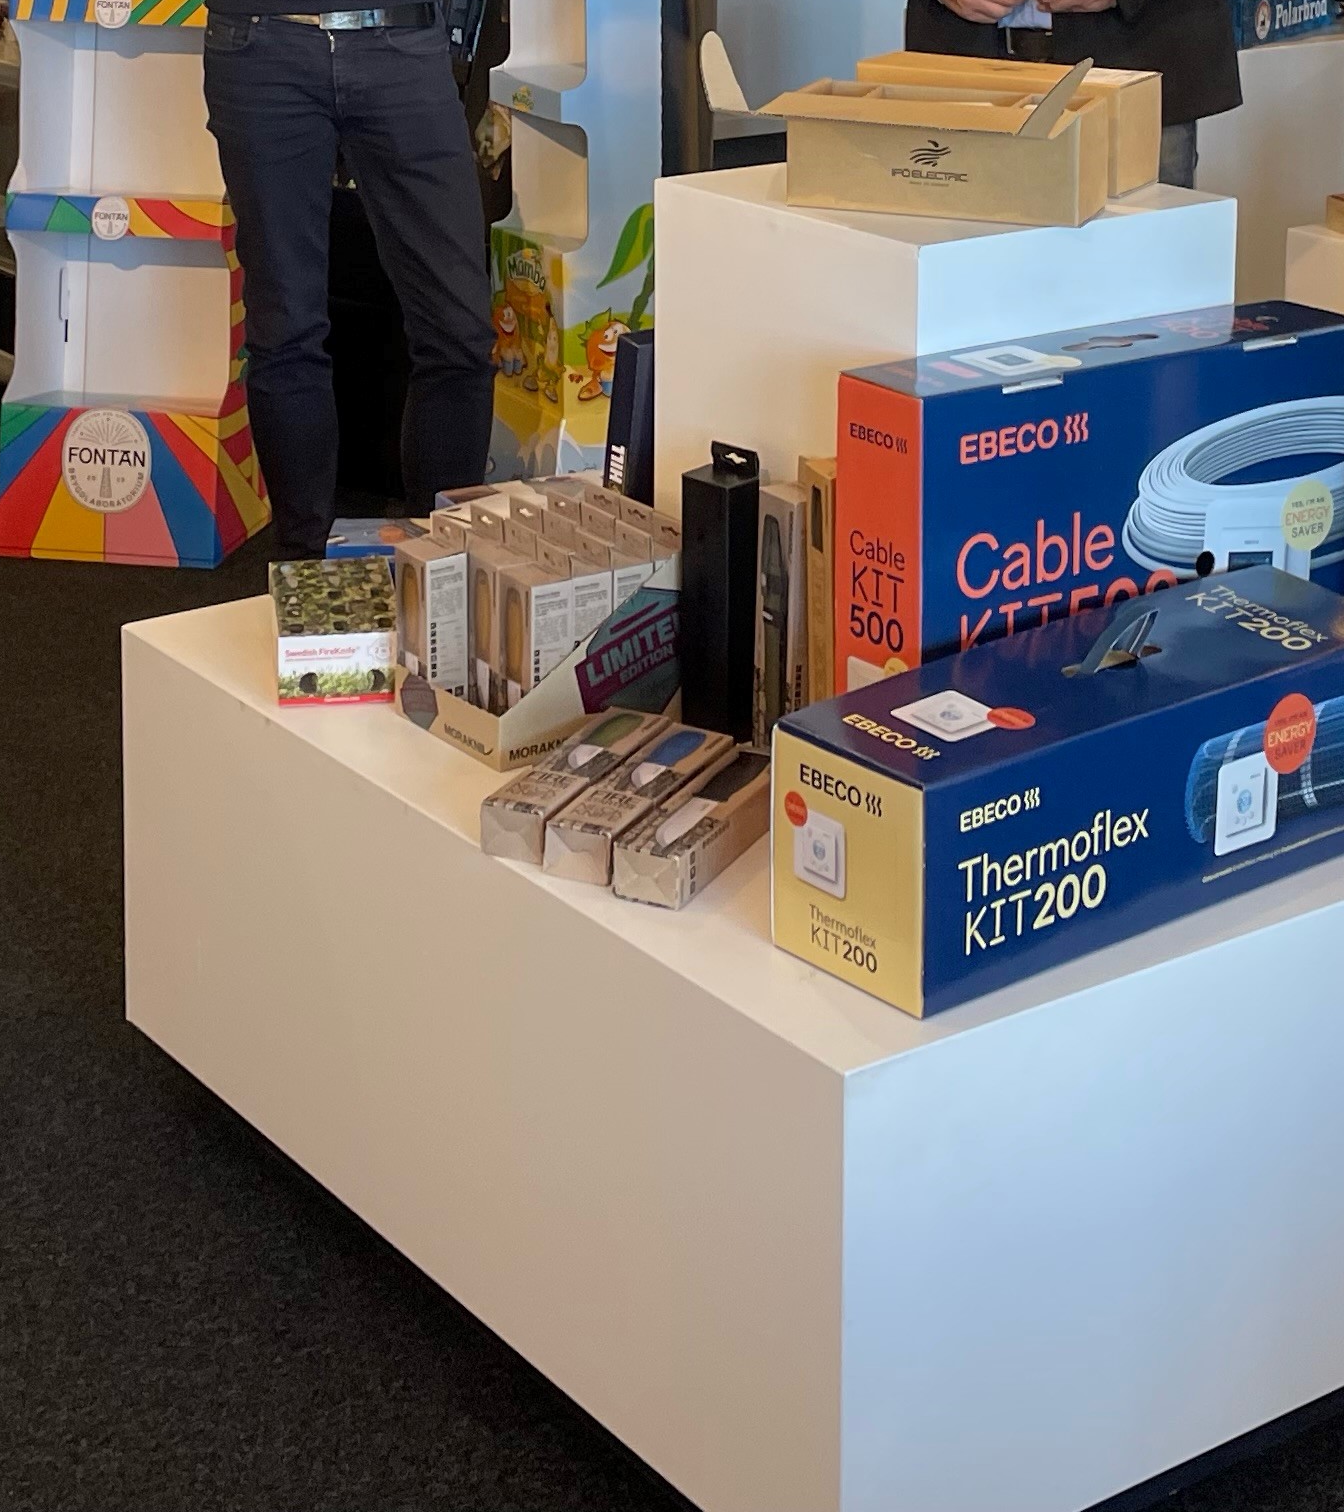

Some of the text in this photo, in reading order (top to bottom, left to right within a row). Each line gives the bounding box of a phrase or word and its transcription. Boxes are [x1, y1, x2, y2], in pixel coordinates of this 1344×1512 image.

[507, 257, 546, 292] Mamba
[849, 422, 894, 450] EBECO
[959, 418, 1059, 465] EBECO
[609, 444, 627, 485] HILL
[1284, 508, 1330, 527] ENERGY
[1291, 522, 1324, 538] SAVER
[849, 530, 905, 571] Cable
[956, 511, 1115, 599] Cable
[852, 561, 905, 613] KIT
[849, 603, 904, 653] 500
[1185, 592, 1313, 651] KIT200
[1211, 585, 1328, 643] Thermoflex
[619, 643, 674, 684] EDITION
[509, 736, 569, 762] MORAKN
[843, 713, 917, 750] EBECO
[1267, 720, 1313, 748] ENERGY
[1274, 739, 1307, 760] SAVER
[800, 763, 861, 808] EBECO
[960, 794, 1021, 833] EBECO
[958, 808, 1149, 903] Thermoflex
[809, 903, 877, 950] Thermoflex
[965, 863, 1107, 956] KIT200
[810, 924, 878, 974] KIT200
